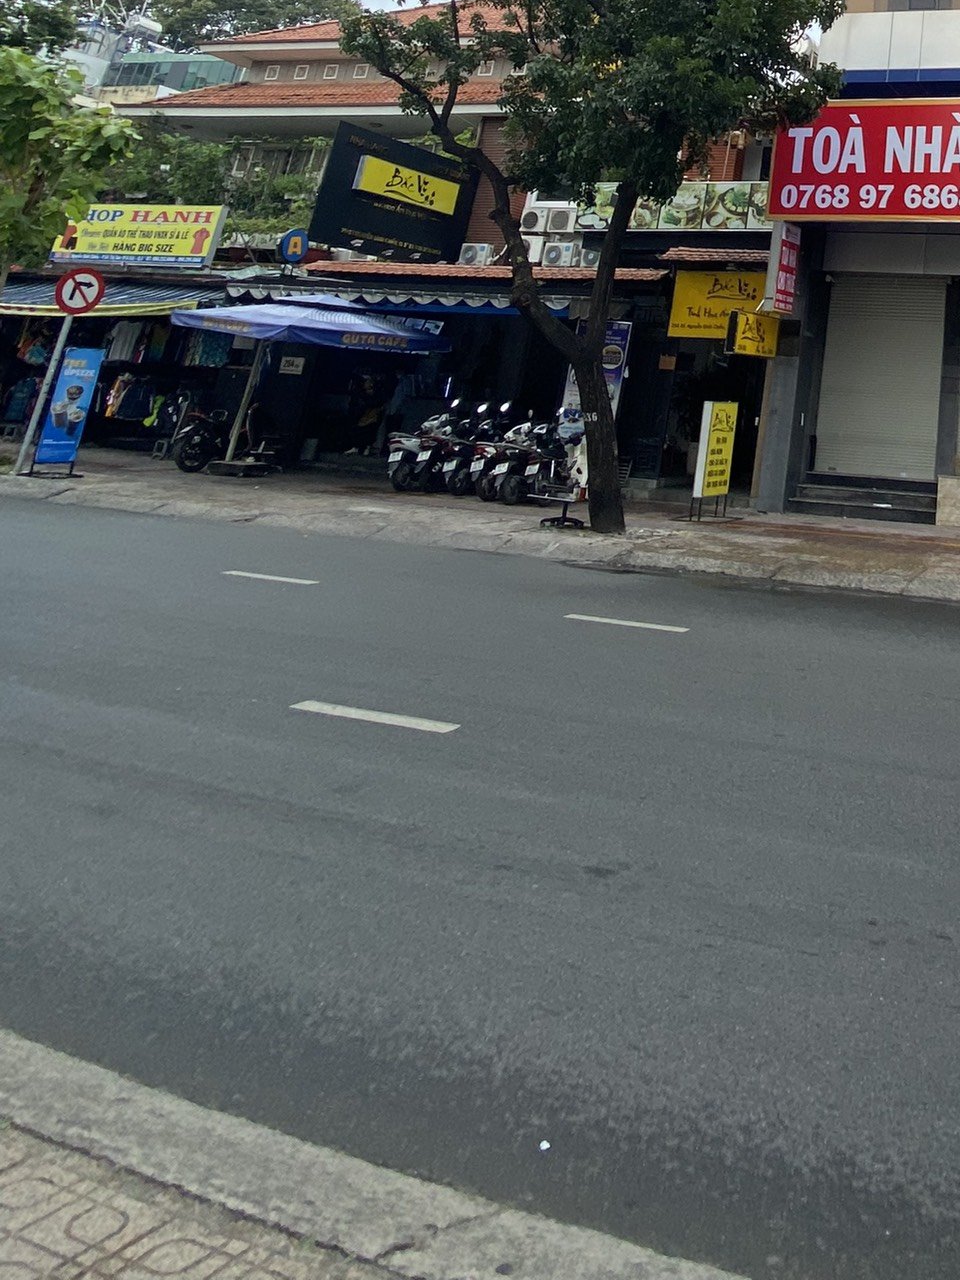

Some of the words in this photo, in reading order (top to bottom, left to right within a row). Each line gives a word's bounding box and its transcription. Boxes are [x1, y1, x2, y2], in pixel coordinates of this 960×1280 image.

[788, 114, 866, 174] TOÀ
[780, 184, 850, 209] 0768
[859, 184, 894, 209] 97
[137, 243, 153, 252] BIG
[155, 243, 175, 253] SIZE
[342, 333, 375, 346] GUTA
